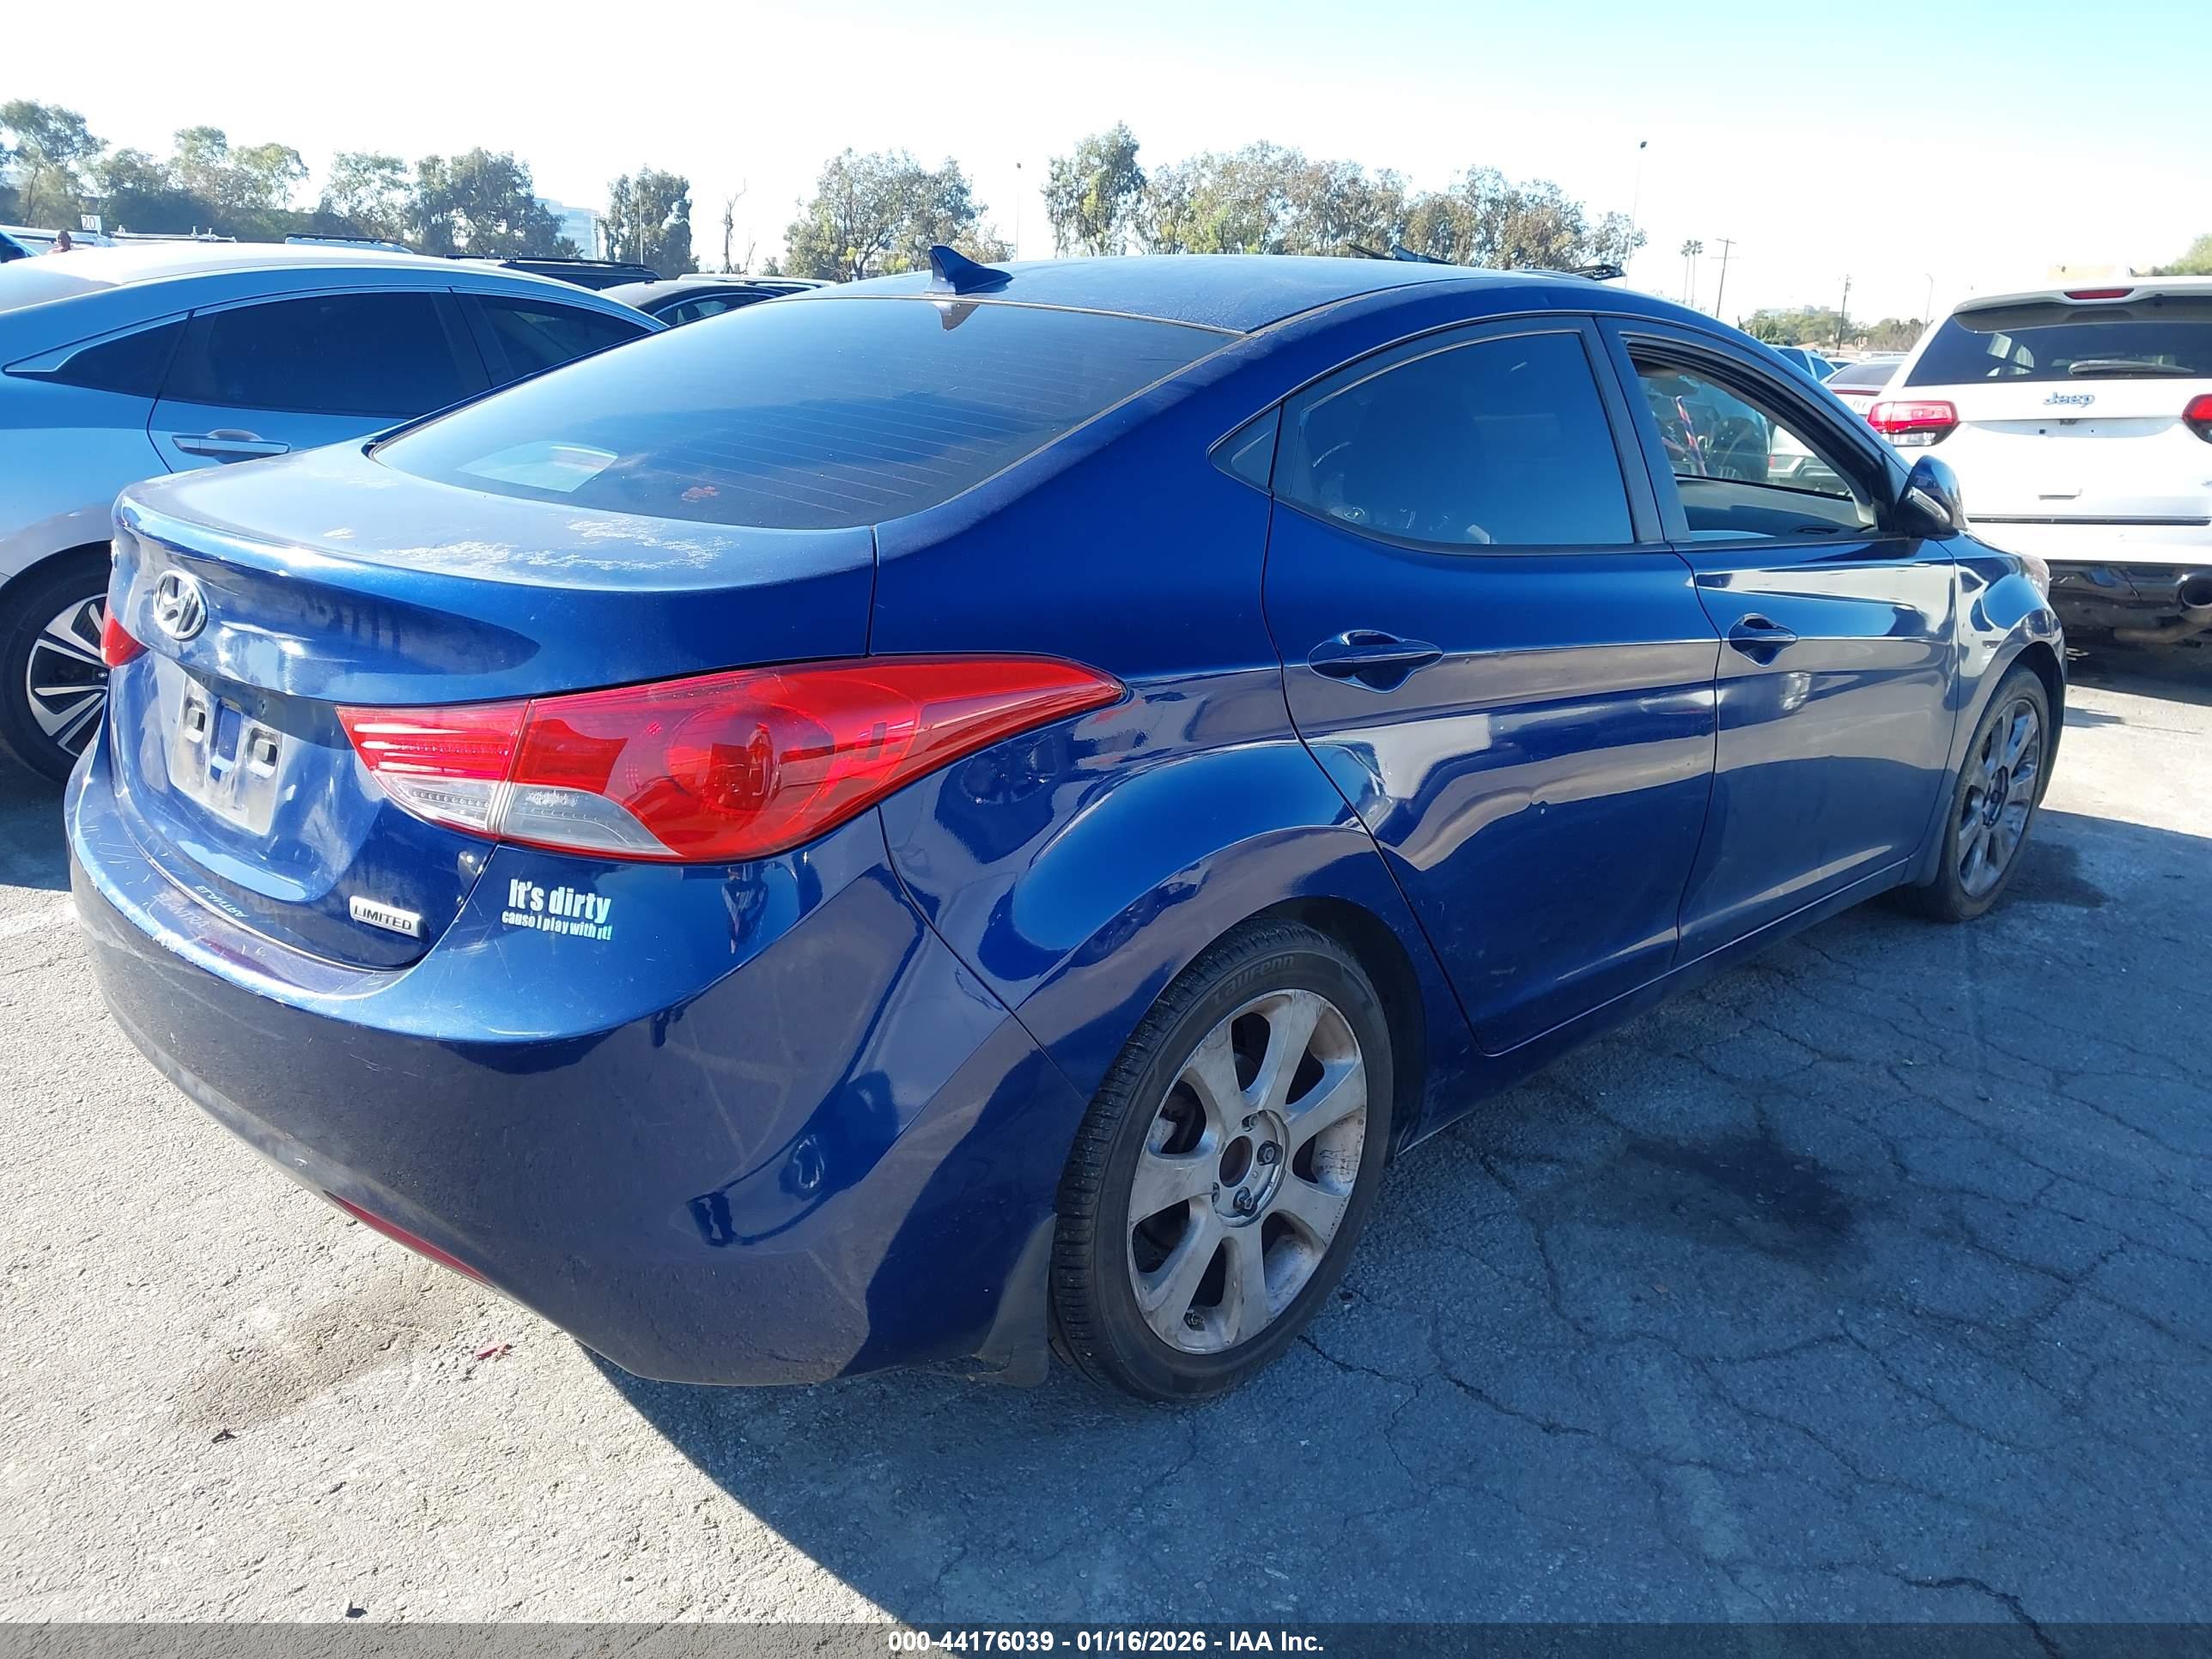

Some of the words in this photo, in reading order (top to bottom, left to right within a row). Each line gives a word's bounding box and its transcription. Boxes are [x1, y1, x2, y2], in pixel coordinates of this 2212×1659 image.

[82, 216, 96, 229] 20
[2042, 391, 2096, 409] Jeep
[507, 878, 544, 912] It's
[548, 886, 611, 924] dirty
[353, 904, 413, 931] LIMITED
[501, 910, 536, 928] cause
[543, 916, 569, 935] play
[569, 921, 597, 939] with
[596, 925, 613, 941] it!
